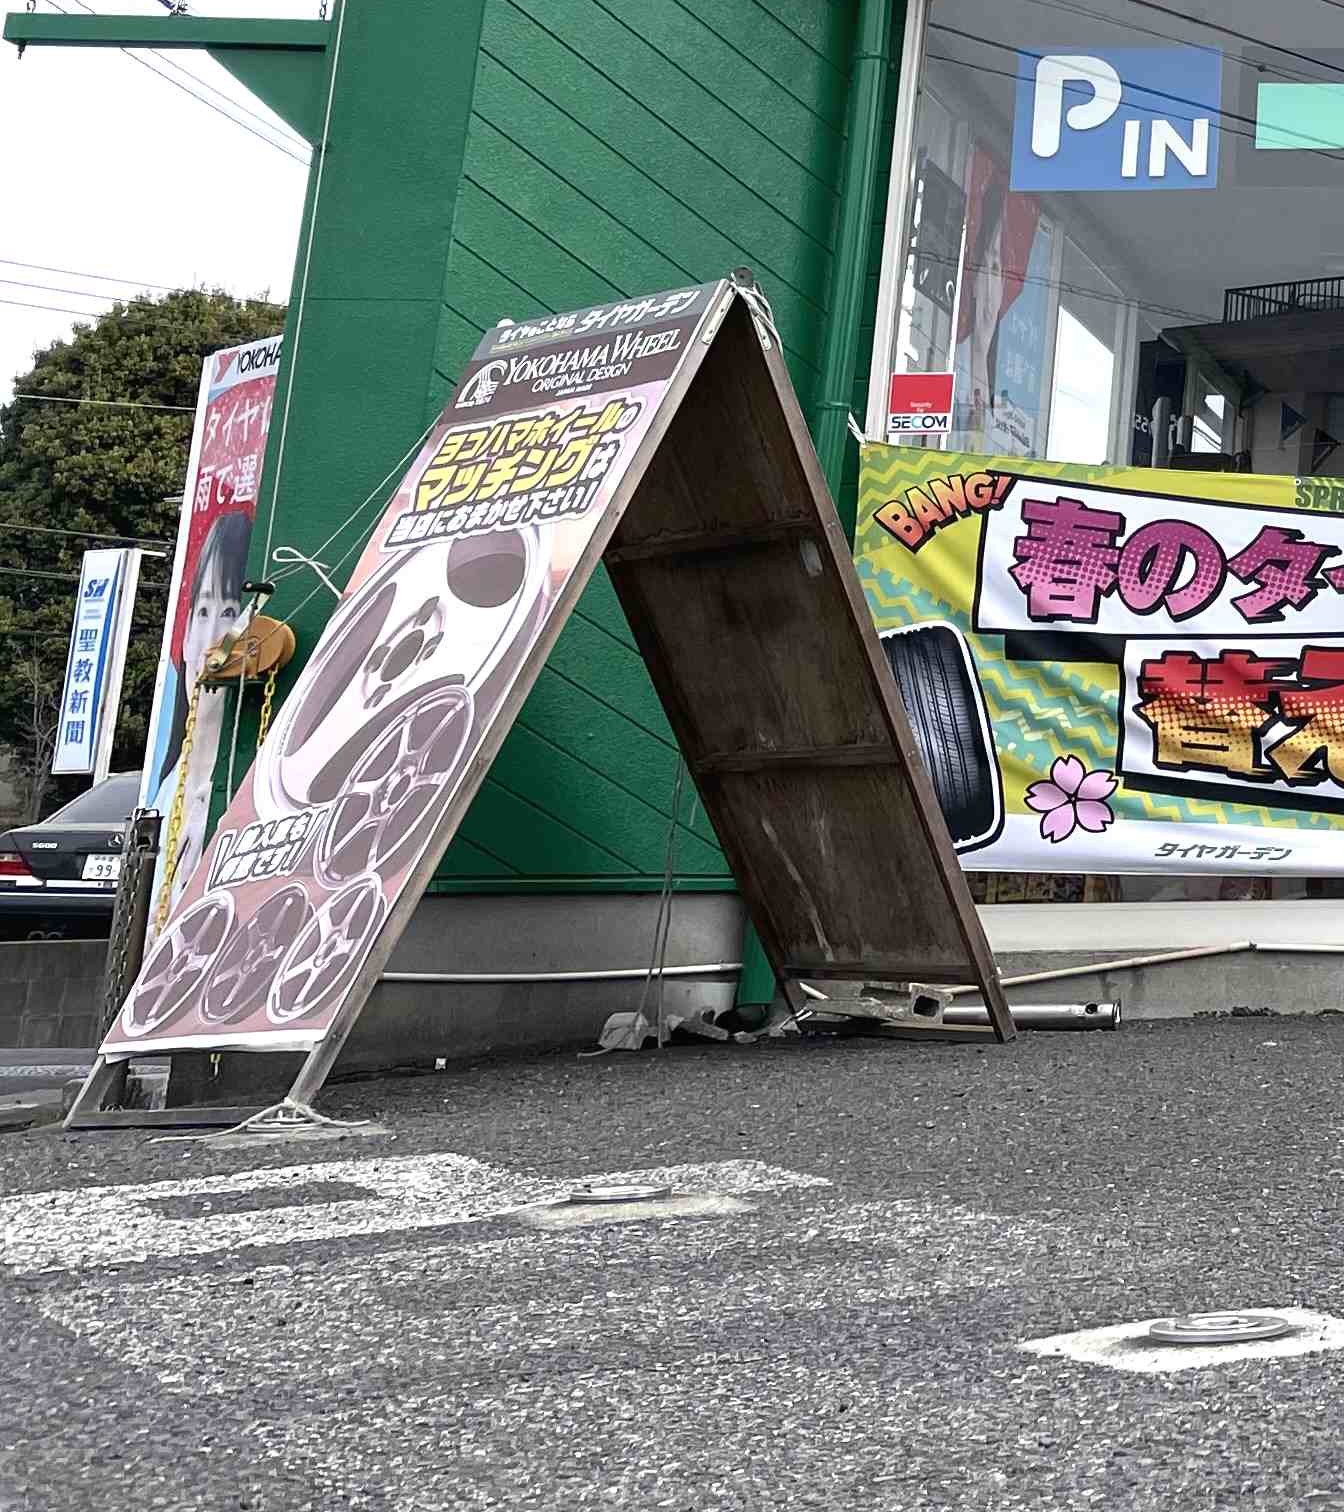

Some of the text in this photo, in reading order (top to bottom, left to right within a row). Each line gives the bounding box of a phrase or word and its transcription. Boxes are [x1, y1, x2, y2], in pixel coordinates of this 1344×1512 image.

[574, 290, 700, 334] タイヤガーデン
[503, 344, 610, 386] YOKOHAMA
[610, 328, 681, 364] WHEEL
[531, 368, 586, 393] ORIGINAL
[588, 360, 632, 382] DESIGN
[891, 416, 948, 429] SECOM
[417, 434, 620, 511] マッチングは
[875, 470, 1012, 553] BANG!
[65, 628, 98, 745] 聖教新聞
[1154, 842, 1292, 862] タイヤガーデン
